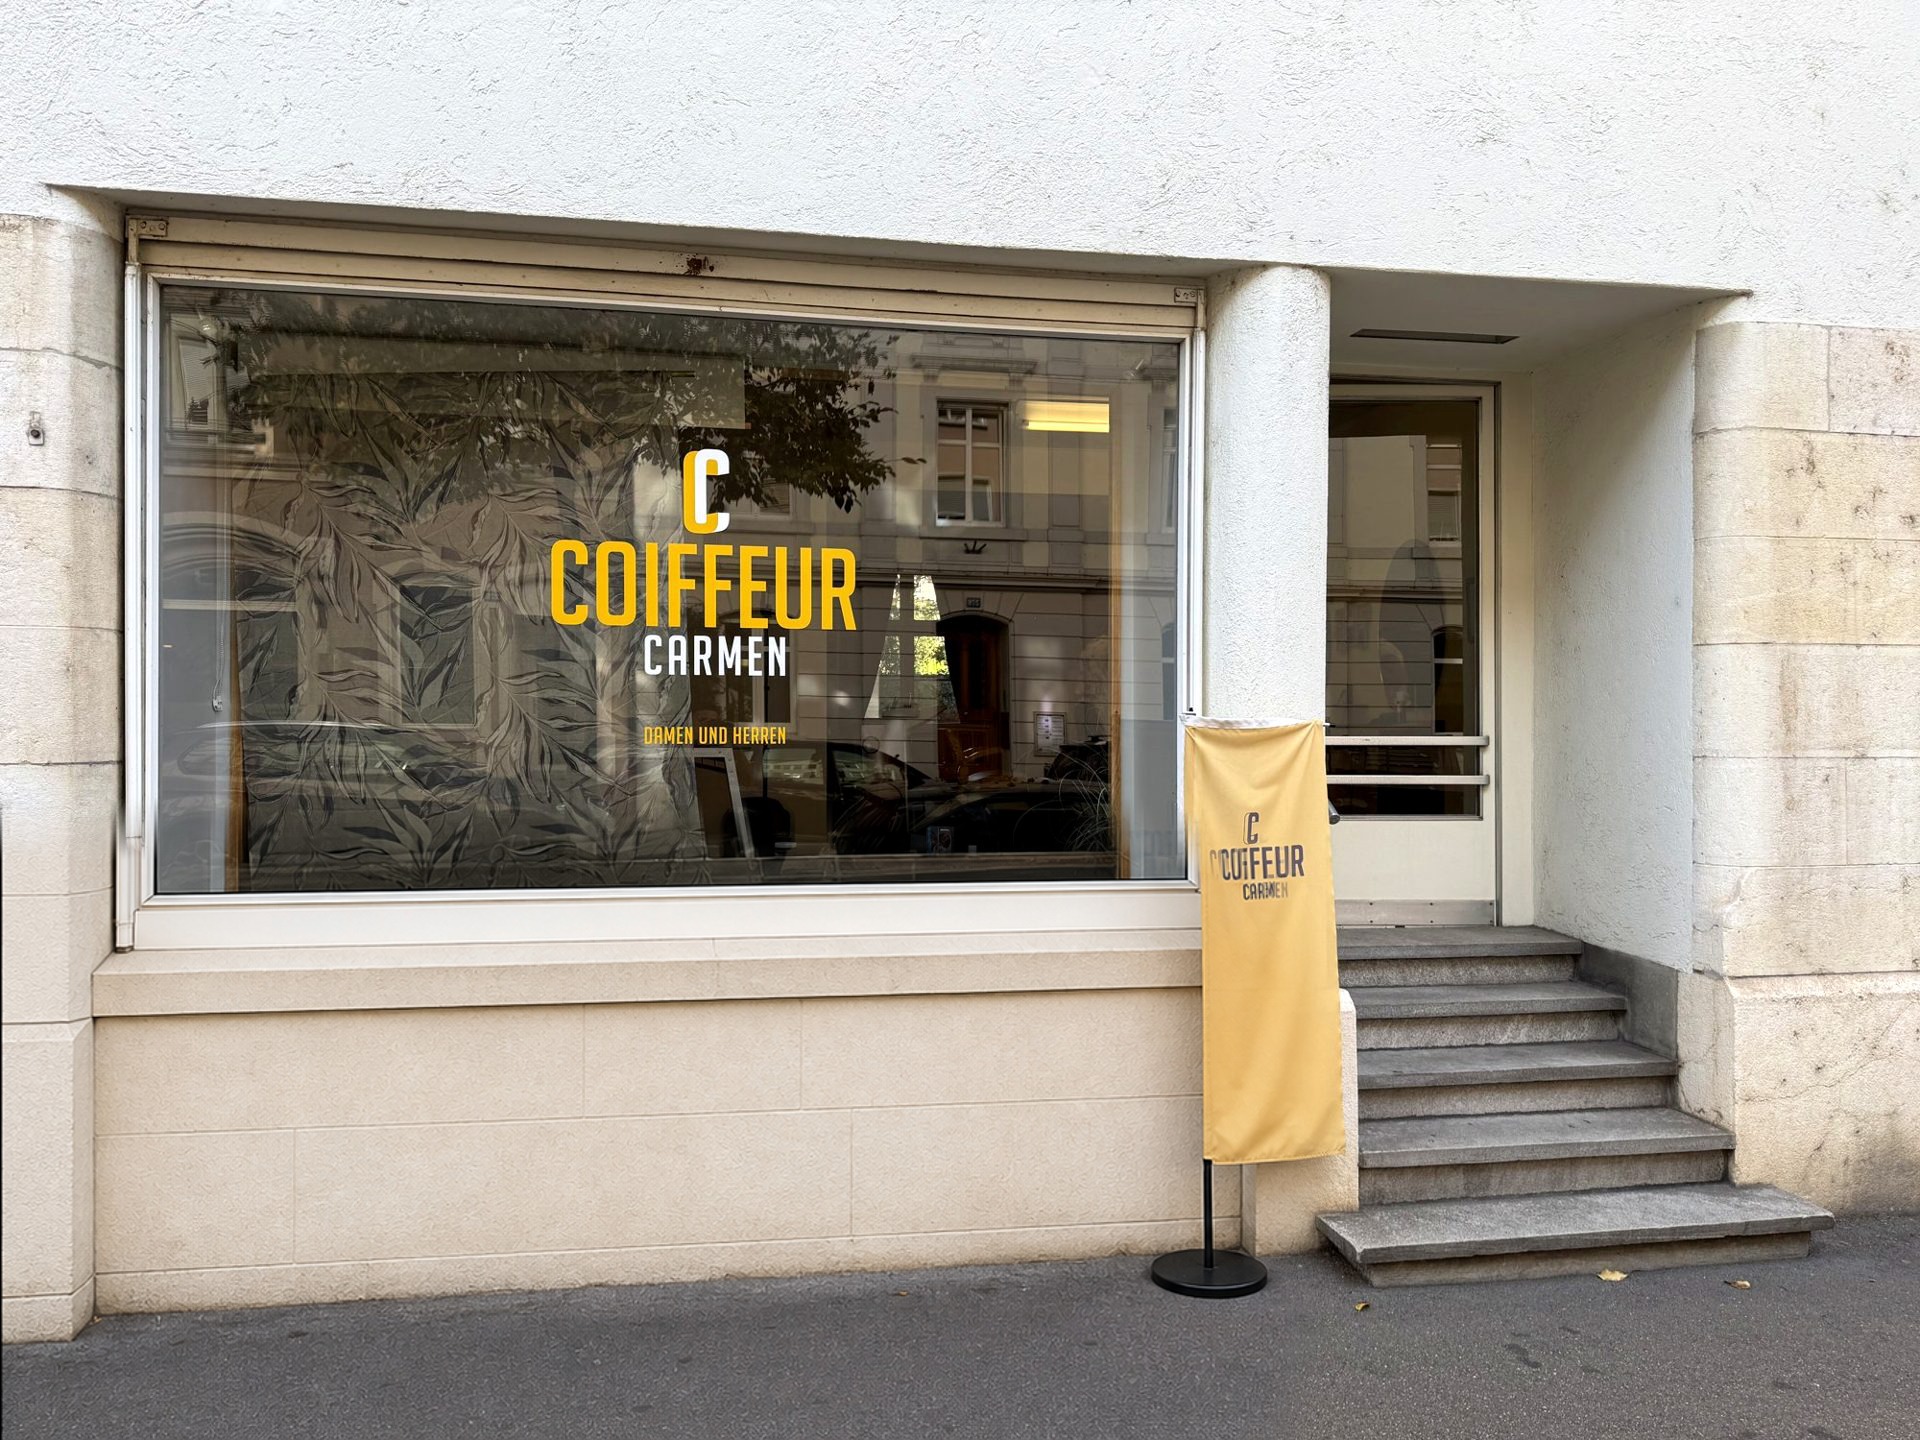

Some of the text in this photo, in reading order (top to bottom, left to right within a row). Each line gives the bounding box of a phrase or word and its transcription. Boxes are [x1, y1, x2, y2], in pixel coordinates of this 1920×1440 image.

[683, 449, 730, 534] C
[551, 539, 857, 631] COIFFEUR
[643, 635, 787, 677] CARMEN
[644, 726, 786, 745] DAMEN UND HERREN
[1242, 812, 1260, 845] C
